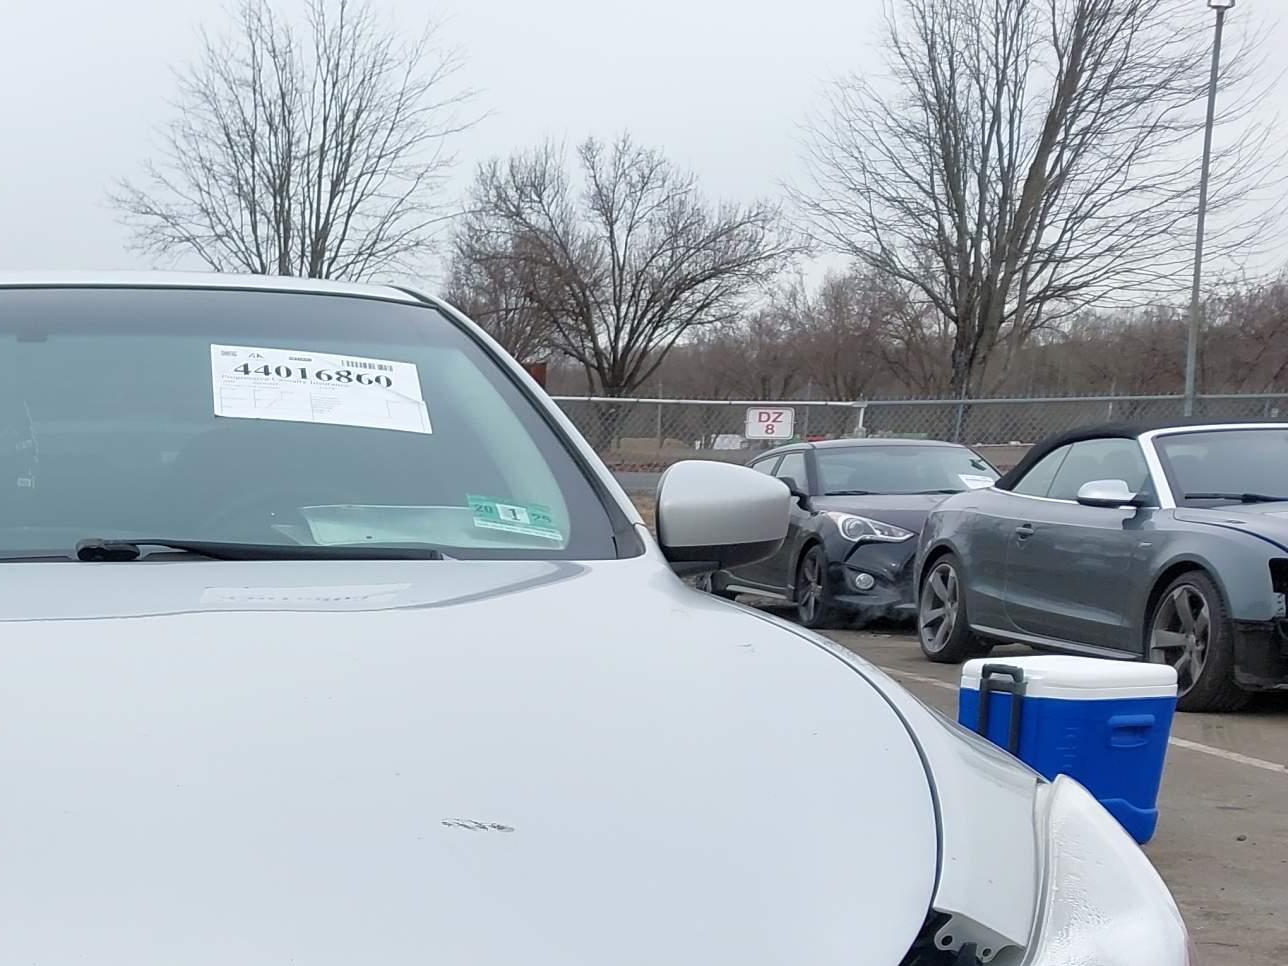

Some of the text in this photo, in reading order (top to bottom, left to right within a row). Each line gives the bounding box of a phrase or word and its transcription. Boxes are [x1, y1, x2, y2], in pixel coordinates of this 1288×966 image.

[233, 362, 393, 388] 44016860
[758, 411, 784, 423] DZ
[764, 423, 776, 435] 8
